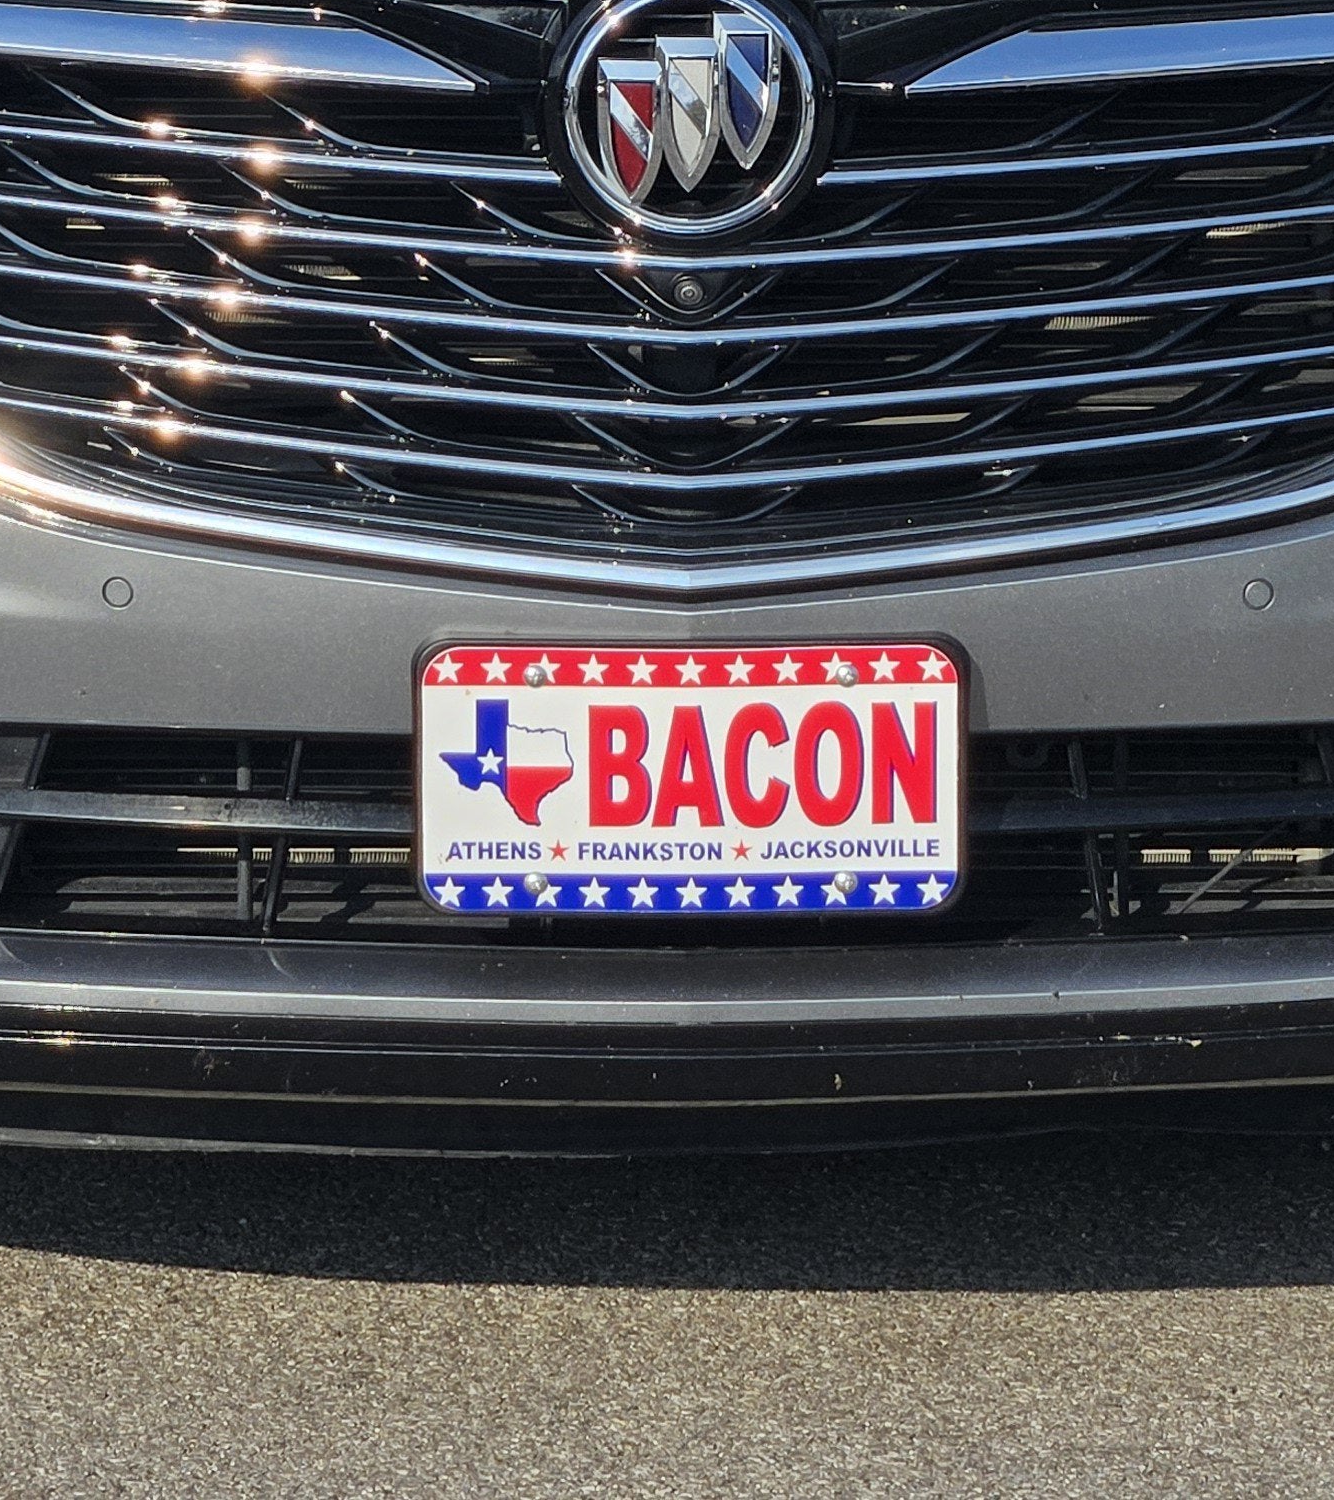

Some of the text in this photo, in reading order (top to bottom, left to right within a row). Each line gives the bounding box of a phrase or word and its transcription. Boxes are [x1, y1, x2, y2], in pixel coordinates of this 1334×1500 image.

[588, 701, 937, 829] BACON
[446, 839, 940, 862] ATHENS FRANKSTON JACKSONVILLE
